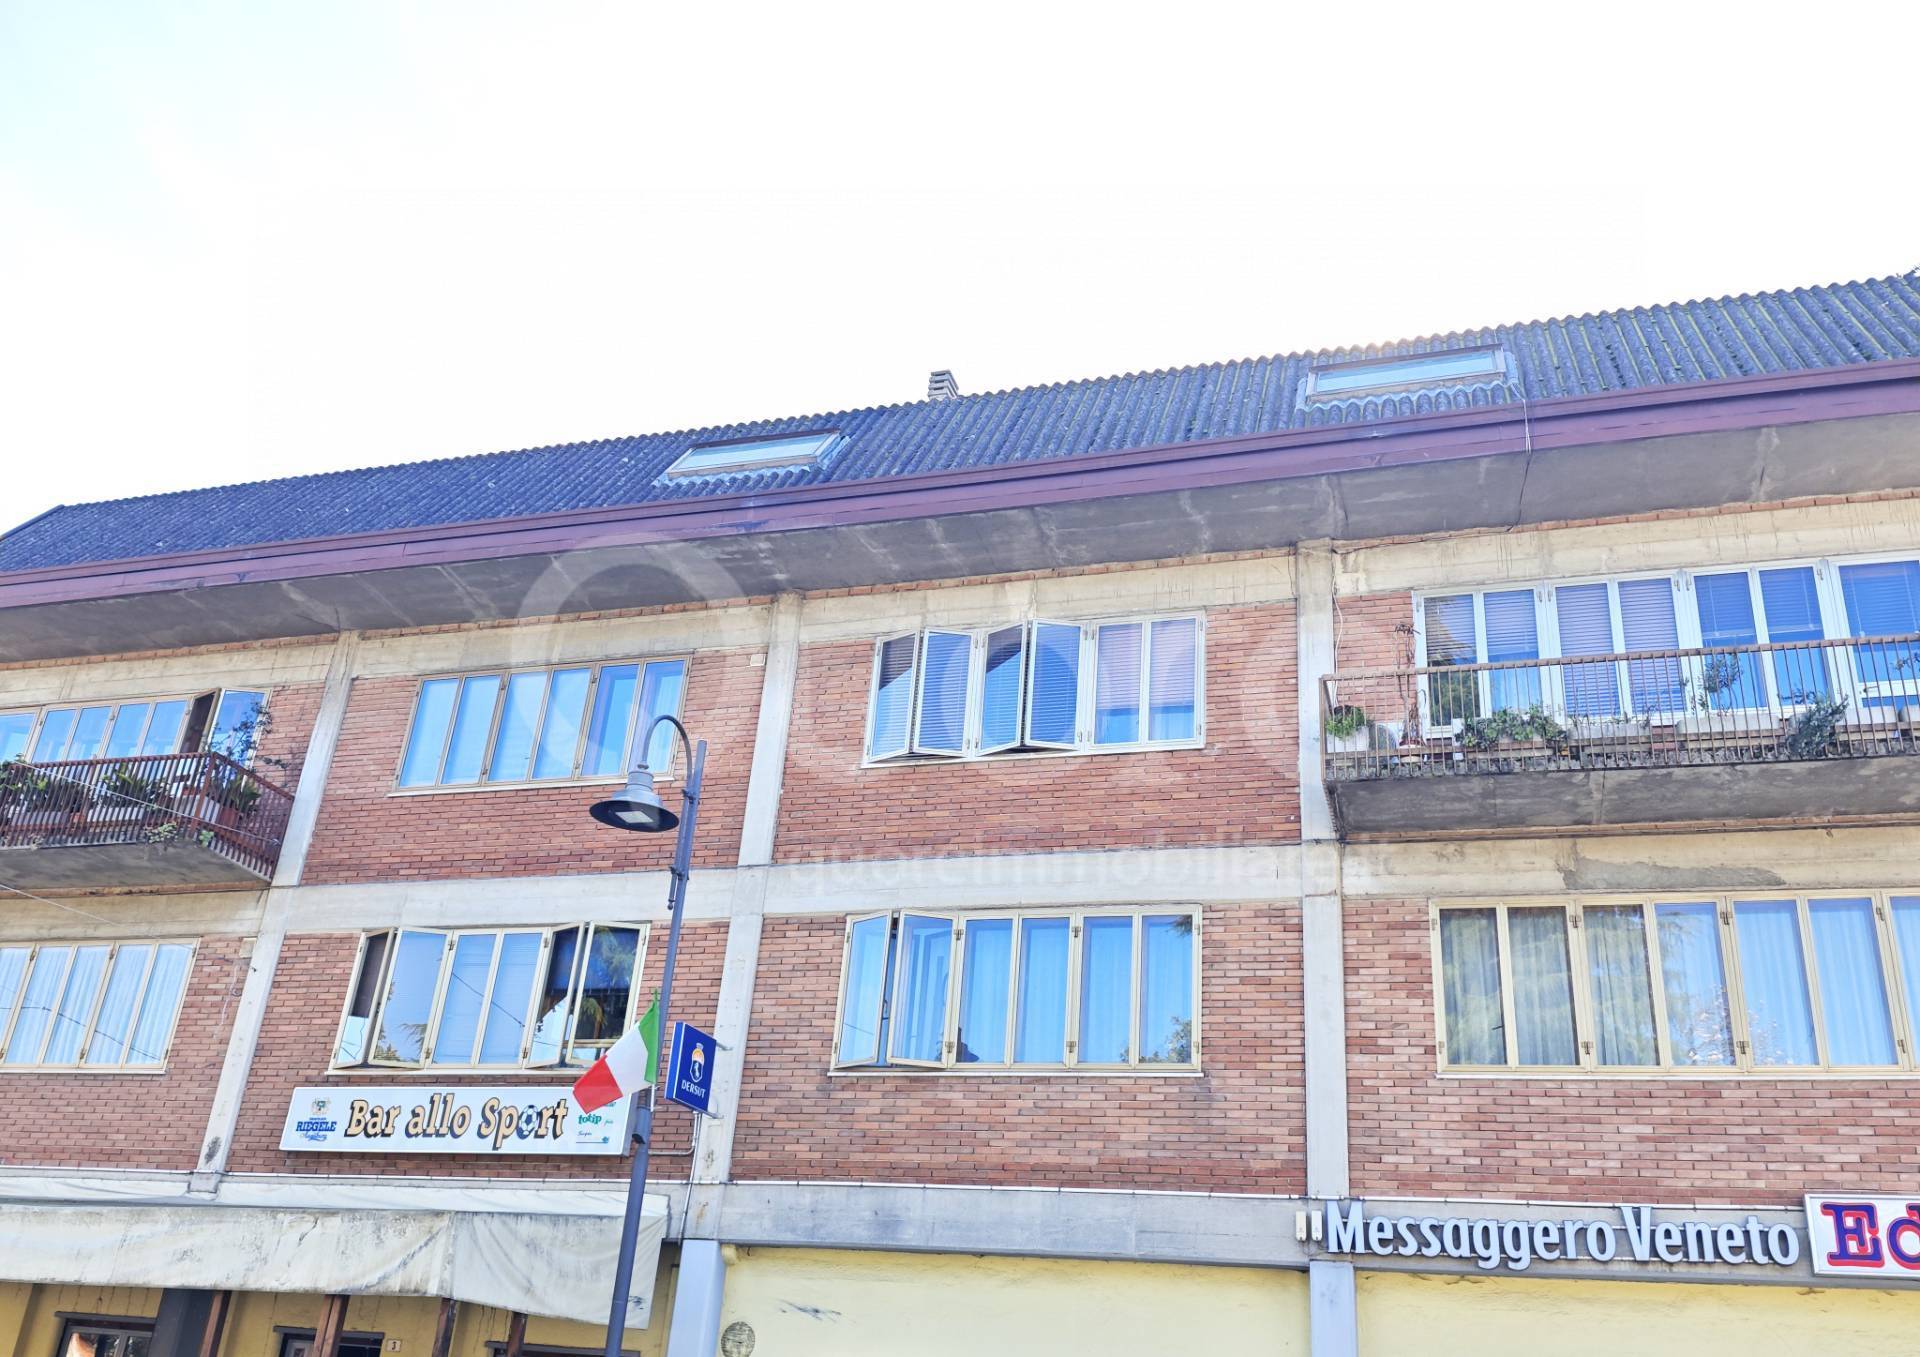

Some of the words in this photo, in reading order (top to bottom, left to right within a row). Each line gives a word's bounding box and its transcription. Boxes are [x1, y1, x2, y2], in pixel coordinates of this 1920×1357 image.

[681, 1079, 706, 1099] DERSUT
[296, 1121, 337, 1132] RIEGELE
[344, 1099, 400, 1138] Bar
[405, 1093, 471, 1139] allo
[477, 1096, 568, 1151] Sport
[1326, 1201, 1617, 1271] Messaggero
[1620, 1206, 1799, 1266] Veneto
